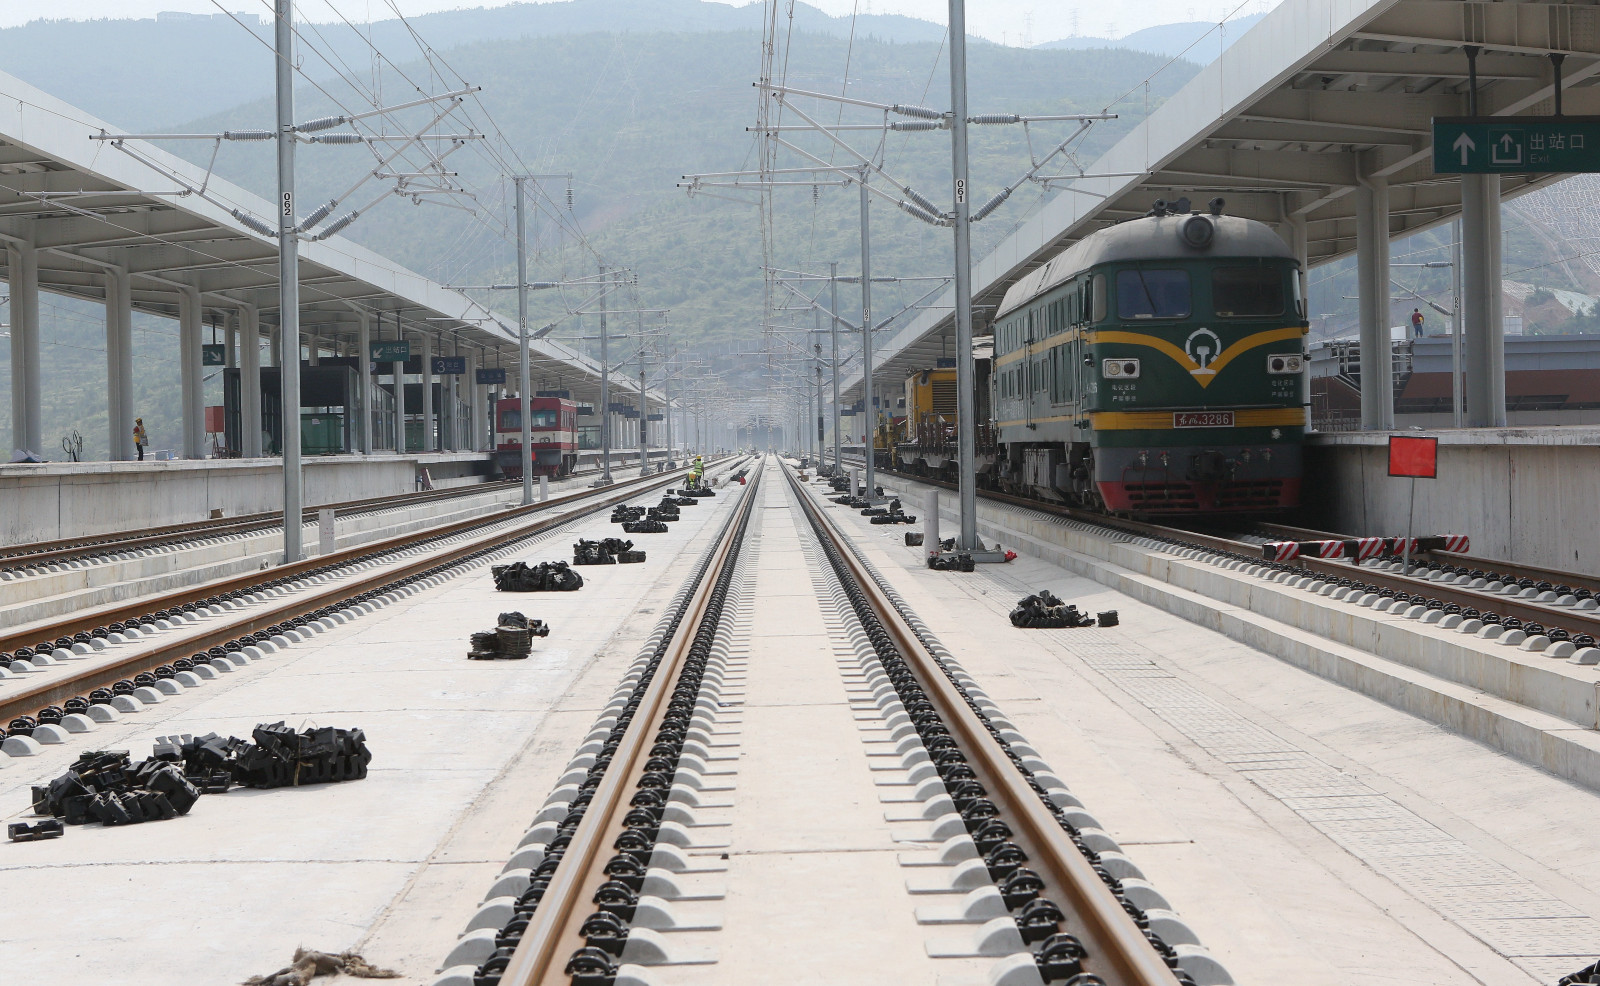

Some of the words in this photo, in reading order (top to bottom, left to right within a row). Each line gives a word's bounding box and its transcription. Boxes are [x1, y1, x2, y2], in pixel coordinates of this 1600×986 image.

[1530, 133, 1584, 150] 出站口
[1530, 154, 1550, 164] Exit
[385, 346, 407, 354] 出站口
[437, 360, 446, 373] 3
[1202, 414, 1229, 425] 3286
